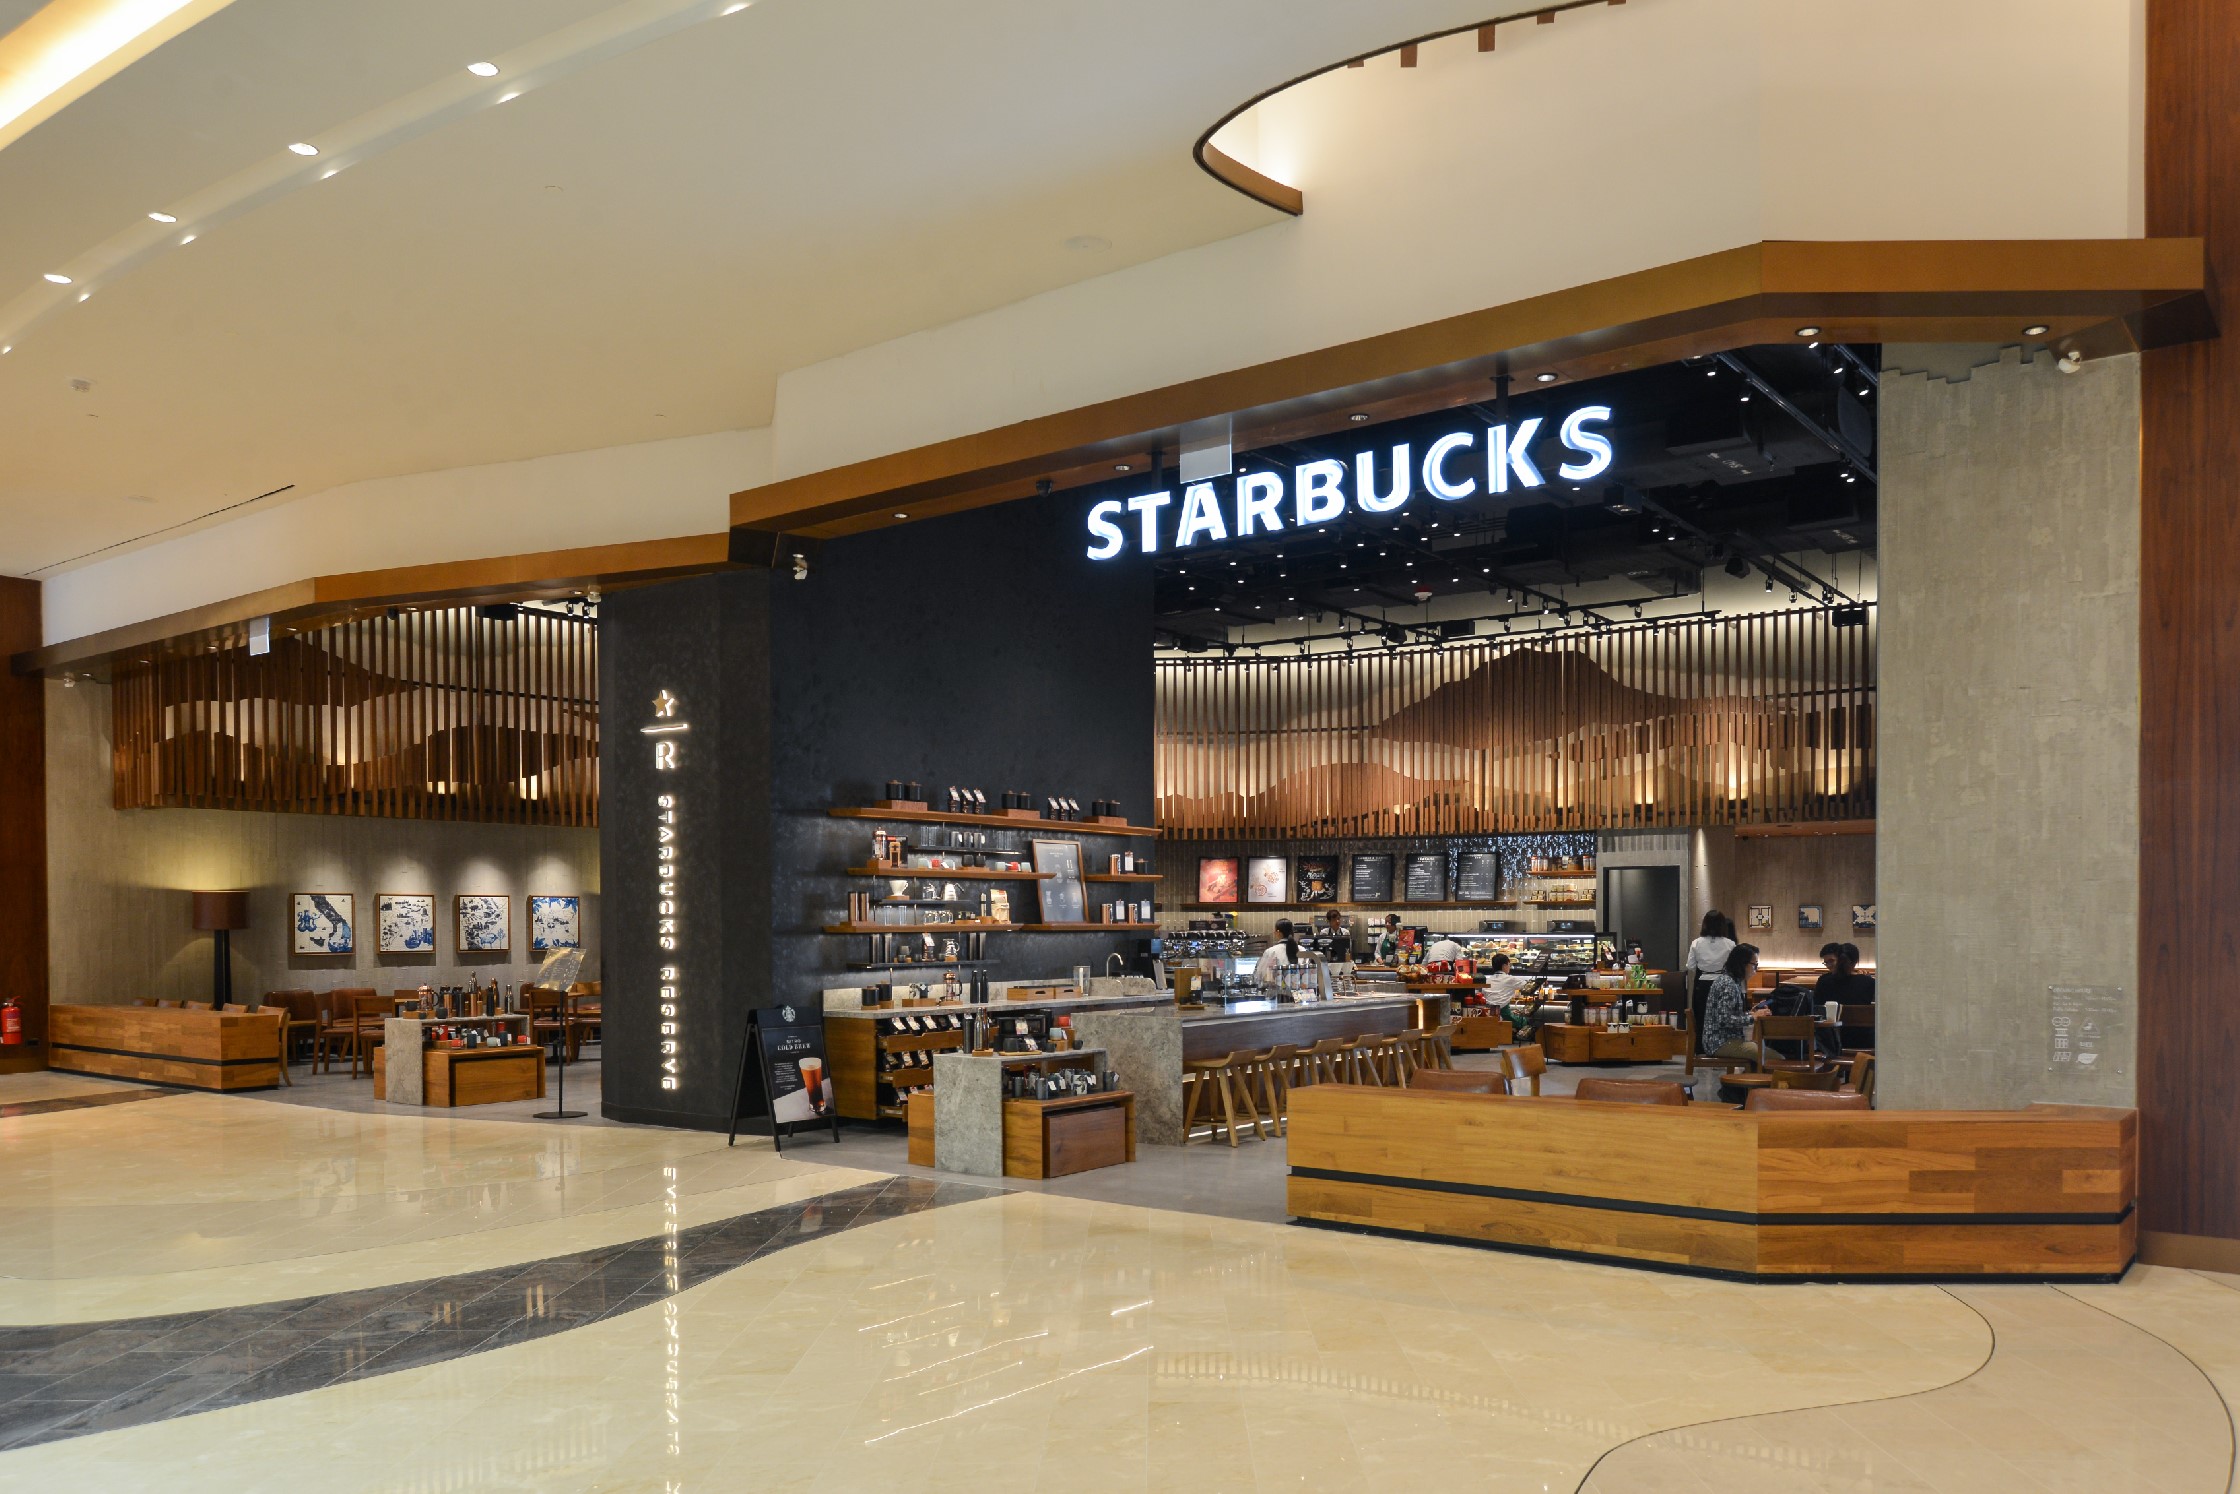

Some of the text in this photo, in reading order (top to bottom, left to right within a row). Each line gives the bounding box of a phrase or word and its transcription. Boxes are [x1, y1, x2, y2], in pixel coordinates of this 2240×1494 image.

[1086, 404, 1613, 562] STARBUCKS
[655, 741, 676, 769] R
[658, 795, 677, 1090] STARBUCKS RESERVE
